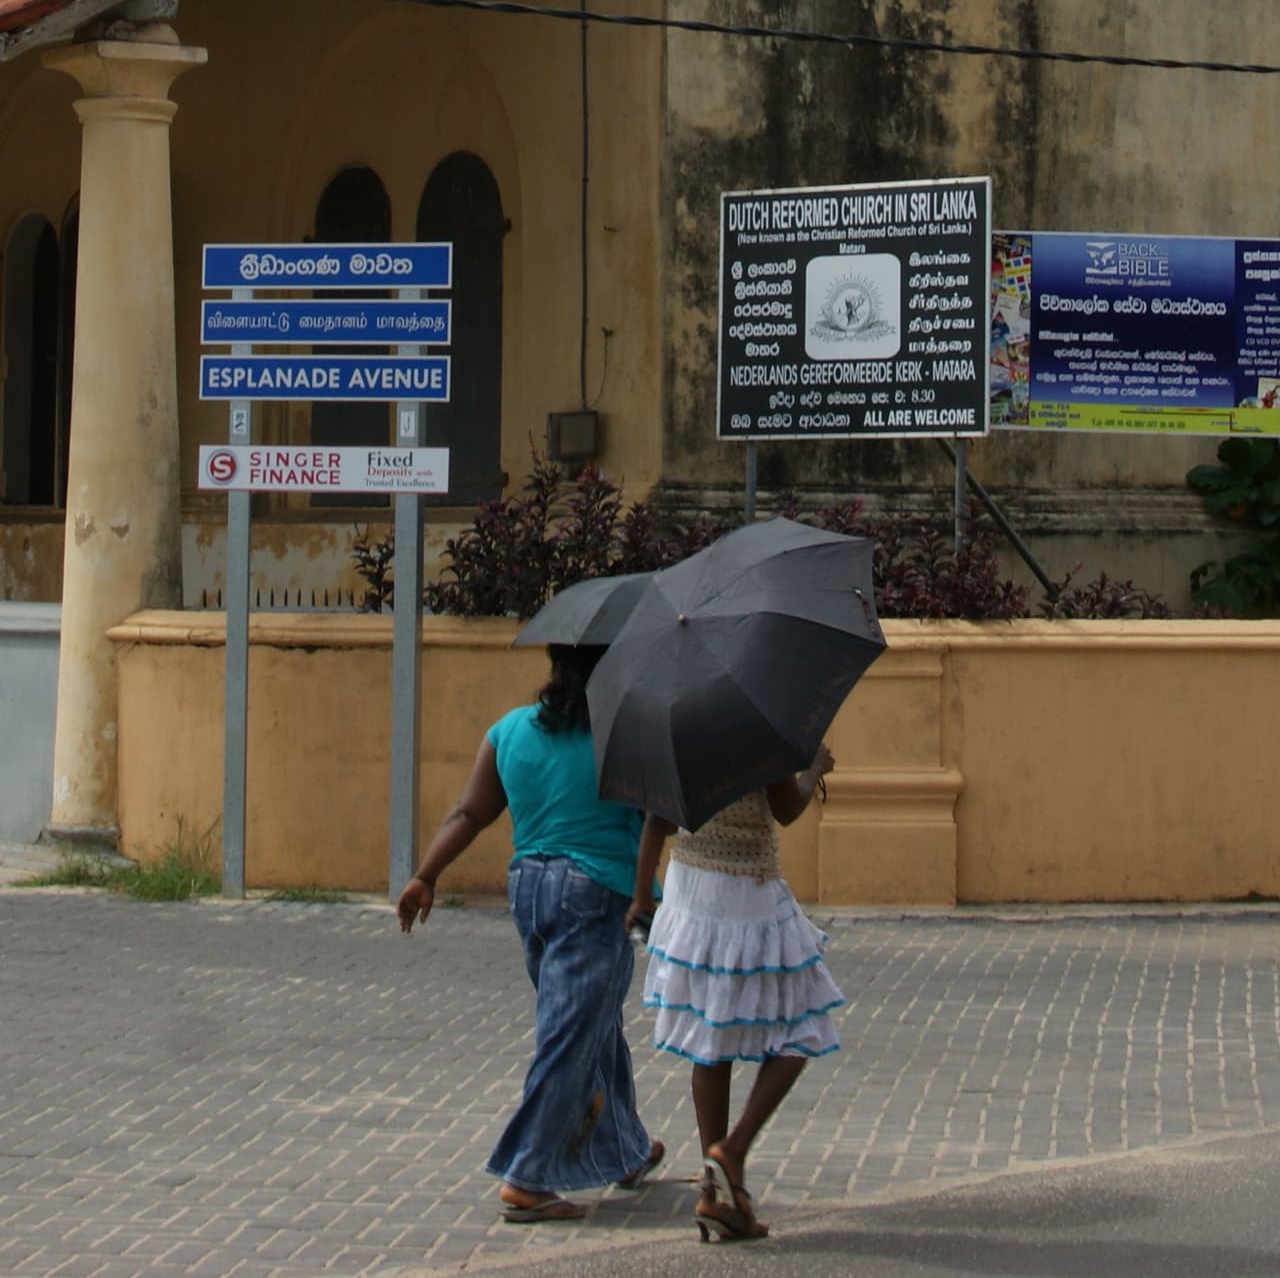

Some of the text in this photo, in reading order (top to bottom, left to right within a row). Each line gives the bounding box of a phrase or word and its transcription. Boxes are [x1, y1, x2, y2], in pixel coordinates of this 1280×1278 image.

[729, 190, 977, 231] DUTCH REFORMED CHURCH IN SRI LANKA
[738, 222, 972, 247] (Now known as the Christian Reformed Church of Sri Lanka.)
[840, 243, 866, 254] Matara
[1118, 243, 1158, 256] BACK
[349, 253, 413, 275] මාවත
[909, 250, 970, 267] இலங்கை
[747, 259, 797, 278] ලංකාවේ
[1118, 260, 1168, 276] BIBLE
[909, 271, 969, 290] கிறிஸ்தவ
[909, 292, 973, 311] சீர்திருத்த
[207, 310, 445, 333] விளையாட்டு மைதானம் மாவத்தை
[907, 315, 975, 334] திருச்சபை
[745, 342, 780, 357] මාතර
[909, 336, 972, 355] மாத்தறை
[208, 367, 442, 389] ESPLANADE AVENUE
[730, 364, 798, 386] NEDERLANDS
[800, 362, 892, 384] GEREFORMEERDE
[896, 361, 922, 382] KERK
[933, 360, 976, 381] MATARA
[911, 389, 935, 402] 8.30
[863, 408, 975, 426] ALL ARE WELCOME
[250, 452, 341, 467] SINGER
[367, 451, 413, 467] Fixed
[250, 469, 341, 484] FINANCE
[367, 466, 413, 478] Deposits
